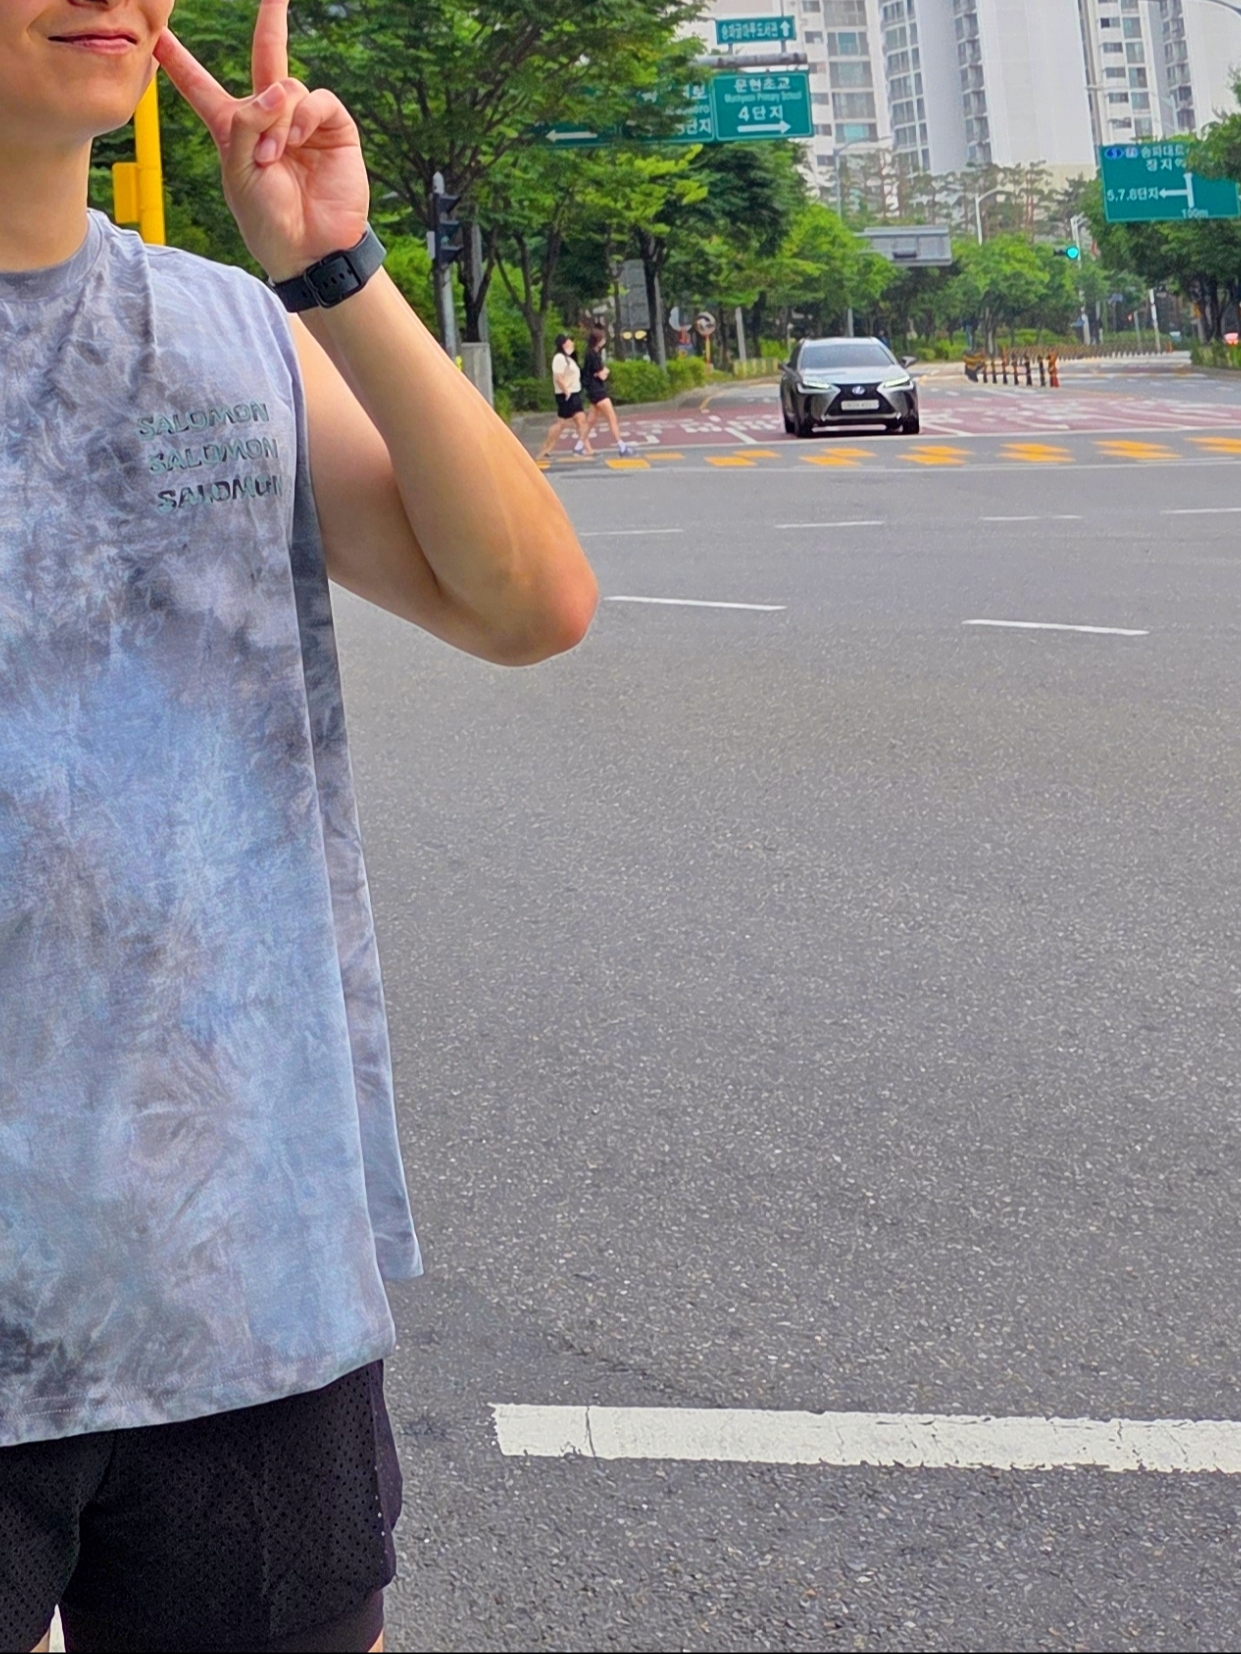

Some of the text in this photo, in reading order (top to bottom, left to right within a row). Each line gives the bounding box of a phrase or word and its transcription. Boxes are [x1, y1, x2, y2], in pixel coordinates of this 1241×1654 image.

[733, 76, 791, 93] 문현초교
[137, 401, 269, 438] SALOMON
[148, 436, 278, 473] SALOMON
[157, 473, 284, 511] SALOMON
